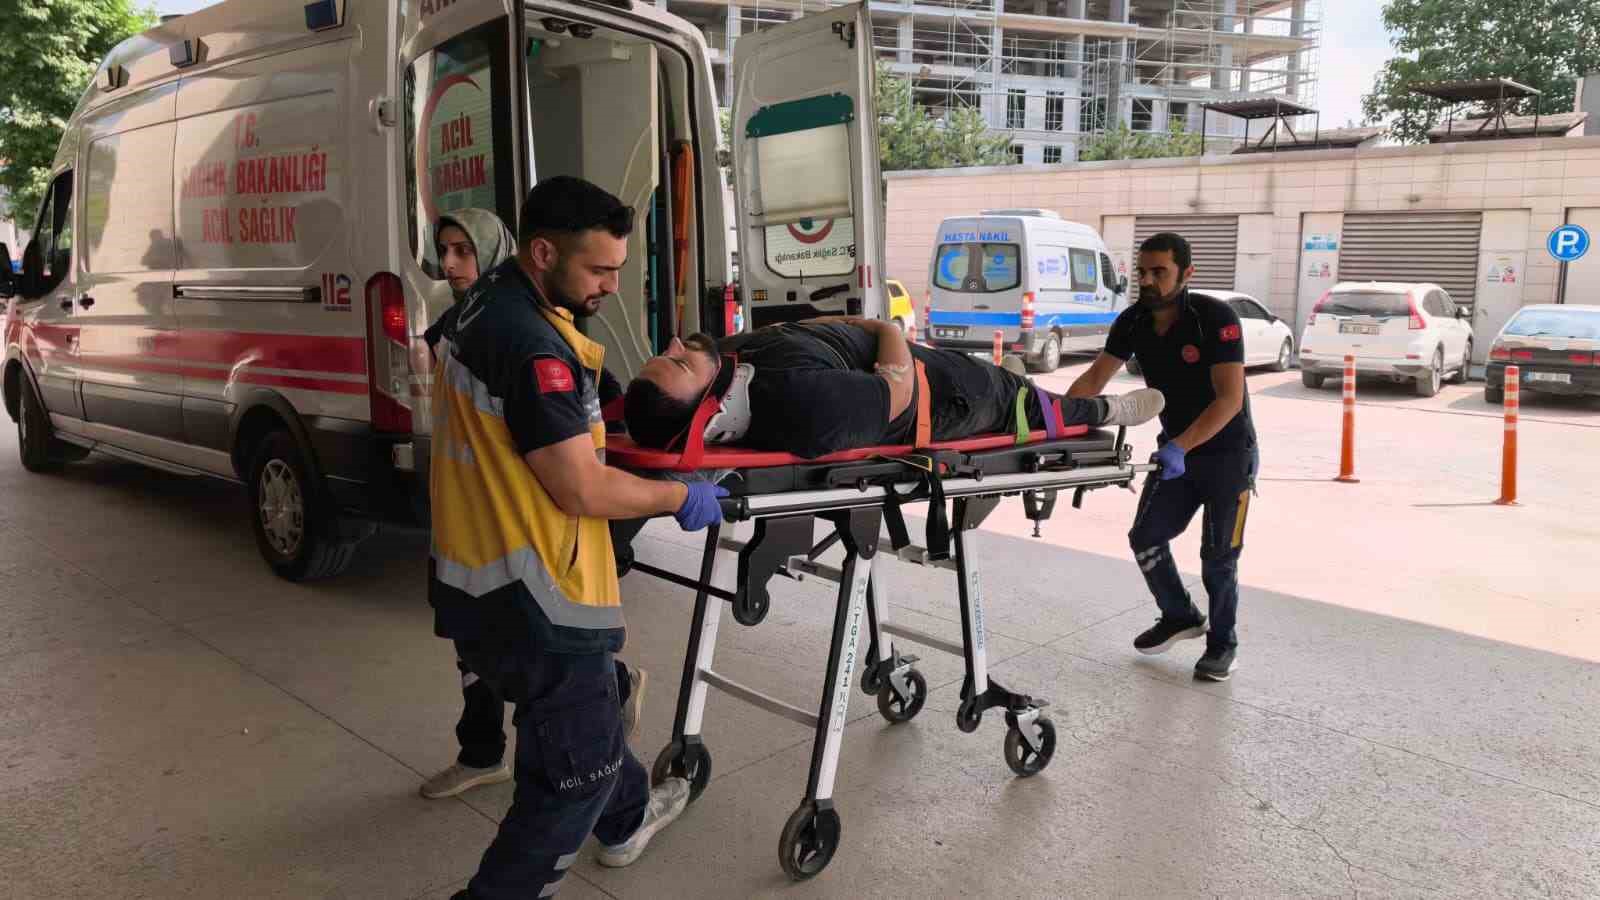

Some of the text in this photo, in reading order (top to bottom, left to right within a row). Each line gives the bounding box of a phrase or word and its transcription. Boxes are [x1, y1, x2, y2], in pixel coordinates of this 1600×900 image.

[236, 144, 327, 194] BAKANLIĞI
[239, 198, 297, 243] SAĞLIK
[1557, 230, 1580, 255] P
[321, 272, 352, 305] 112
